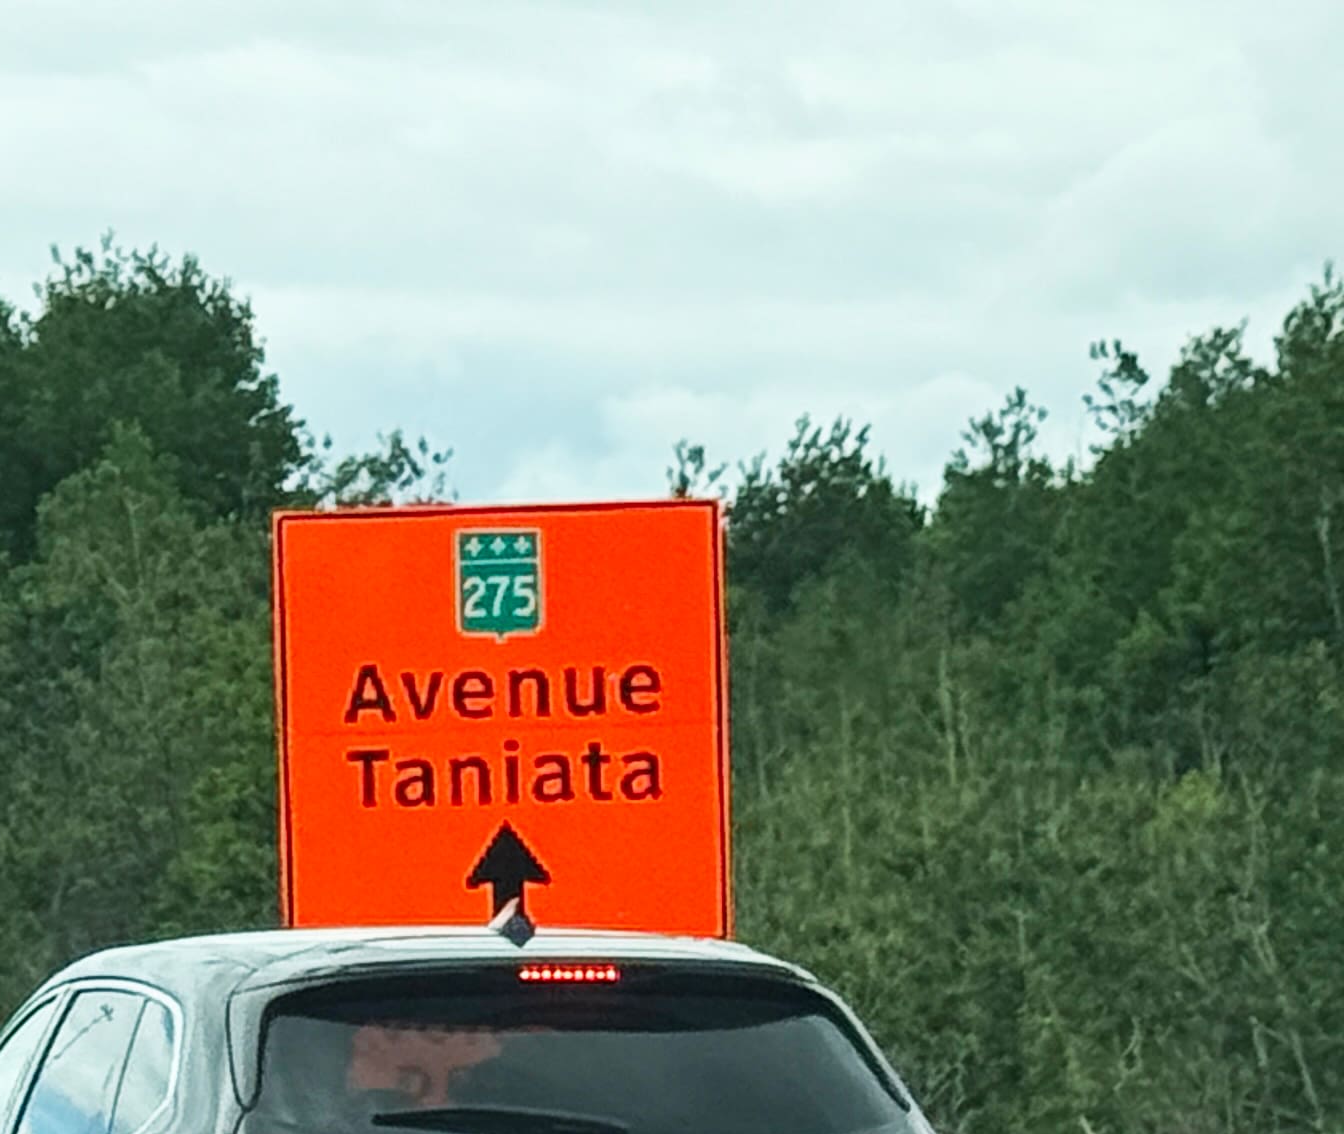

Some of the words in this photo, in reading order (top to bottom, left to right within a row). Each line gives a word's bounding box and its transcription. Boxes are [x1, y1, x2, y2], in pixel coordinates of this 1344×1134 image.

[462, 575, 537, 618] 275
[343, 663, 662, 723] Avenue
[346, 740, 663, 808] Taniata
